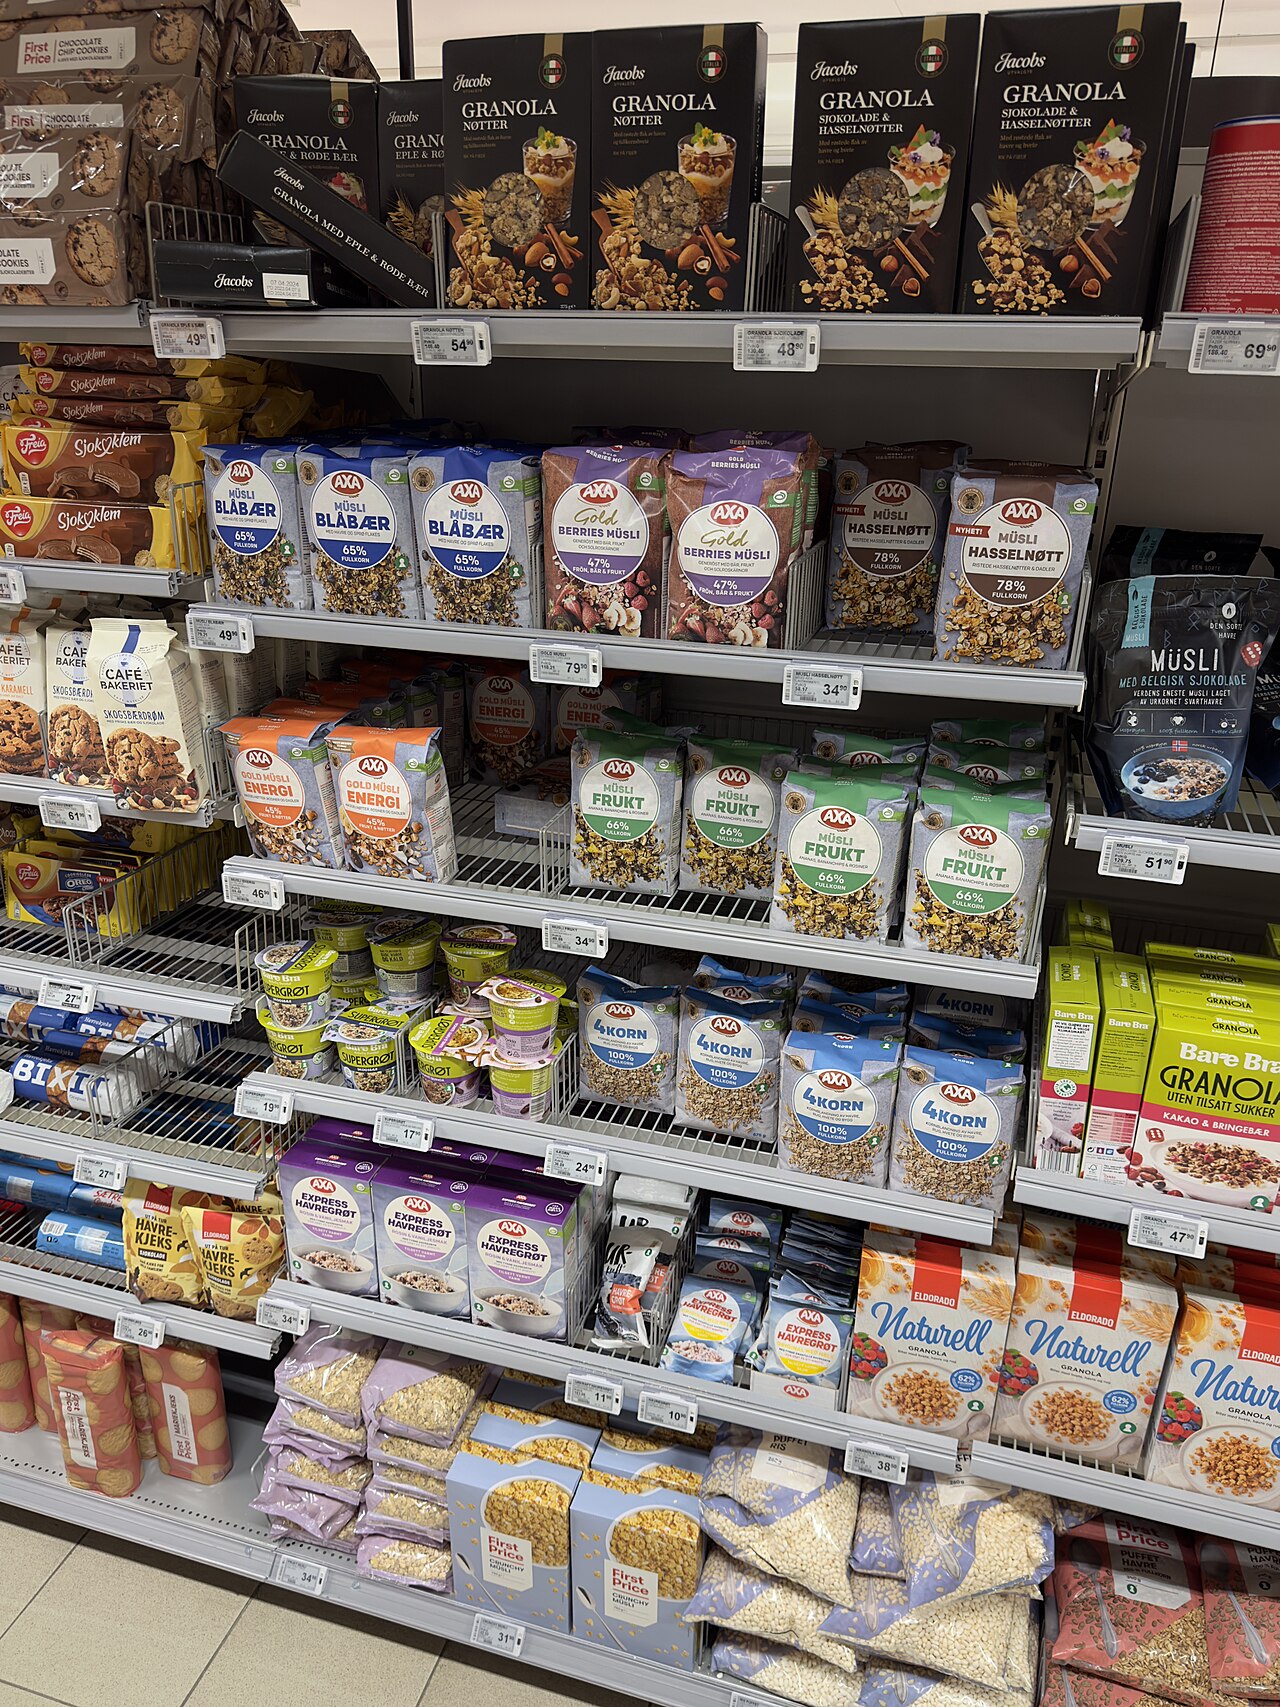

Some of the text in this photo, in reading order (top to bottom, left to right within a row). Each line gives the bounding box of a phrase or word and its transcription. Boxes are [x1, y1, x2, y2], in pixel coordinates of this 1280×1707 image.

[25, 42, 48, 52] First
[59, 38, 102, 48] CHOCOLATE
[58, 46, 108, 56] CHIP COOKIES
[24, 54, 51, 65] Price
[994, 52, 1046, 73] Jacobs
[603, 65, 645, 85] Jacobs
[1003, 81, 1127, 104] GRANOLA
[612, 94, 717, 113] GRANOLA
[247, 109, 284, 124] Jacobs
[386, 111, 419, 126] Jacobs
[1001, 107, 1067, 118] SJOKOLADE
[613, 115, 663, 127] NØTTER
[1000, 117, 1092, 130] HASSELNØTTER
[301, 151, 330, 161] RØDE
[333, 152, 358, 162] BÆR
[274, 167, 305, 191] Jacobs
[273, 186, 320, 223] GRANOLA
[321, 219, 344, 239] MED
[345, 236, 370, 257] EPLE
[380, 259, 407, 283] RØDE
[407, 278, 429, 298] BÆR
[214, 273, 254, 289] Jacobs
[20, 435, 47, 455] Freia
[334, 474, 362, 490] AXA
[454, 484, 480, 498] AXA
[582, 483, 614, 499] AXA
[334, 501, 366, 513] MÜSLI
[713, 504, 745, 521] AXA
[1004, 503, 1038, 521] AXA
[5, 506, 32, 527] Freia
[315, 512, 390, 531] BLÅBÆR
[450, 508, 483, 521] MÜSLI
[573, 507, 619, 526] Gold
[428, 520, 504, 539] BLÅBÆR
[558, 526, 640, 539] BERRIES MÜSLI
[955, 526, 983, 535] NYHET!
[700, 529, 748, 548] Gold
[998, 531, 1038, 545] MÜSLI
[343, 545, 367, 556] 65%
[684, 547, 770, 560] BERRIES MÜSLI
[968, 546, 1064, 562] HASSELNØTT
[455, 554, 480, 565] 65%
[587, 558, 610, 568] 47%
[454, 565, 482, 573] FULLKORN
[713, 580, 738, 590] 47%
[996, 579, 1026, 592] 78%
[992, 591, 1028, 600] FULLKORN
[105, 667, 143, 681] CAFÉ
[1119, 674, 1247, 688] MED BELGISK SJOKOLADE
[1, 685, 33, 695] KARAMELL
[100, 681, 153, 691] BAKERIET
[104, 709, 165, 721] SKOGSBÆRDRØM
[362, 758, 384, 772] AXA
[346, 780, 400, 794] GOLD MÜSLI
[603, 783, 634, 794] MÜSLI
[347, 790, 400, 809] ENERGI
[592, 792, 645, 810] FRUKT
[366, 818, 385, 827] 45%
[822, 810, 852, 826] AXA
[606, 821, 630, 831] 66%
[818, 833, 854, 846] MÜSLI
[963, 827, 994, 844] AXA
[804, 841, 865, 863] FRUKT
[958, 849, 995, 863] MÜSLI
[942, 858, 1007, 881] FRUKT
[818, 872, 845, 884] 66%
[815, 881, 846, 891] FULLKORN
[607, 1005, 633, 1015] AXA
[1212, 1022, 1260, 1036] GRANOLA
[342, 1051, 394, 1066] SUPERGRØT
[607, 1051, 634, 1061] 100%
[1179, 1041, 1240, 1067] Bare
[821, 1073, 849, 1087] AXA
[1167, 1091, 1276, 1118] UTEN TILSATT SUKKER
[1163, 1112, 1270, 1137] KAKAO & BRINGEBÆR
[145, 1200, 170, 1213] ELDORADO
[135, 1218, 178, 1237] HAVRE-
[135, 1232, 172, 1250] KJEKS
[488, 1234, 539, 1252] EXPRESS
[481, 1242, 548, 1262] HAVREGRØT
[914, 1291, 955, 1307] ELDORADO
[1071, 1311, 1114, 1328] ELDORADO
[786, 1324, 832, 1342] EXPRESS
[870, 1301, 993, 1356] Naturell
[777, 1331, 838, 1353] HAVREGRØT
[1024, 1319, 1152, 1378] Naturell
[908, 1345, 947, 1357] GRANOLA
[1060, 1364, 1102, 1378] GRANOLA
[785, 1384, 808, 1398] AXA
[169, 1394, 180, 1434] MARIEKJEKS
[488, 1535, 518, 1552] First
[1117, 1529, 1169, 1549] Price
[488, 1545, 524, 1562] Price
[1121, 1550, 1160, 1562] PUFFET
[489, 1558, 525, 1572] CRUNCHY
[490, 1563, 511, 1573] MÜSLI
[1122, 1558, 1157, 1570] HAVRE
